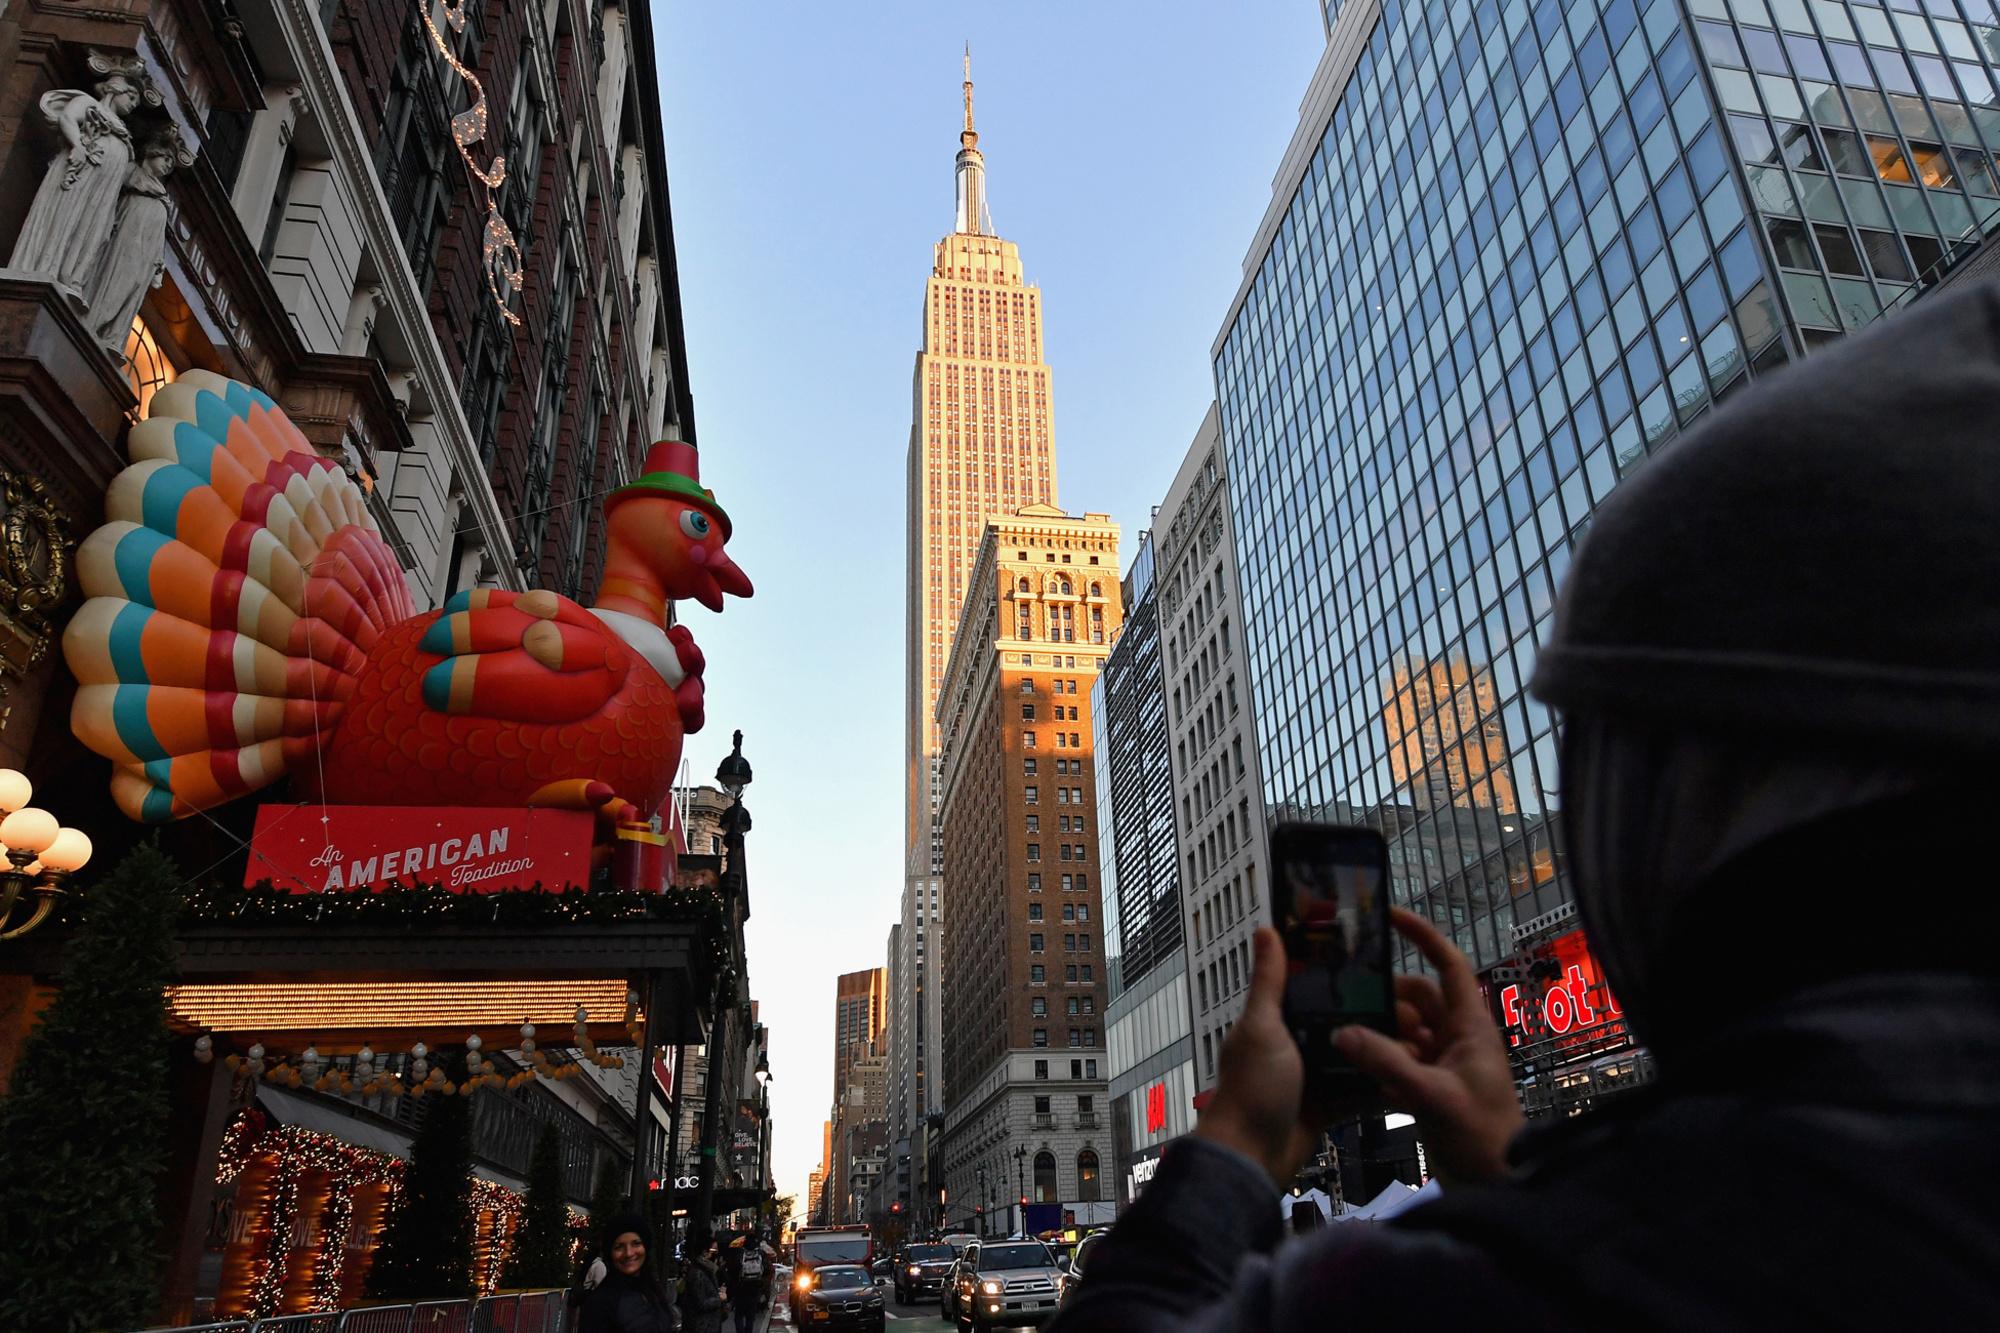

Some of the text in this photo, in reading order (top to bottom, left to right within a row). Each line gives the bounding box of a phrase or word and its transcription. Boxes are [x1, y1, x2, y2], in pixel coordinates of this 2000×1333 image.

[309, 844, 344, 868] An
[322, 827, 509, 893] AMERICAN
[451, 857, 534, 887] Tradition
[1132, 1154, 1161, 1184] verizo
[1416, 1141, 1428, 1178] TISSOT
